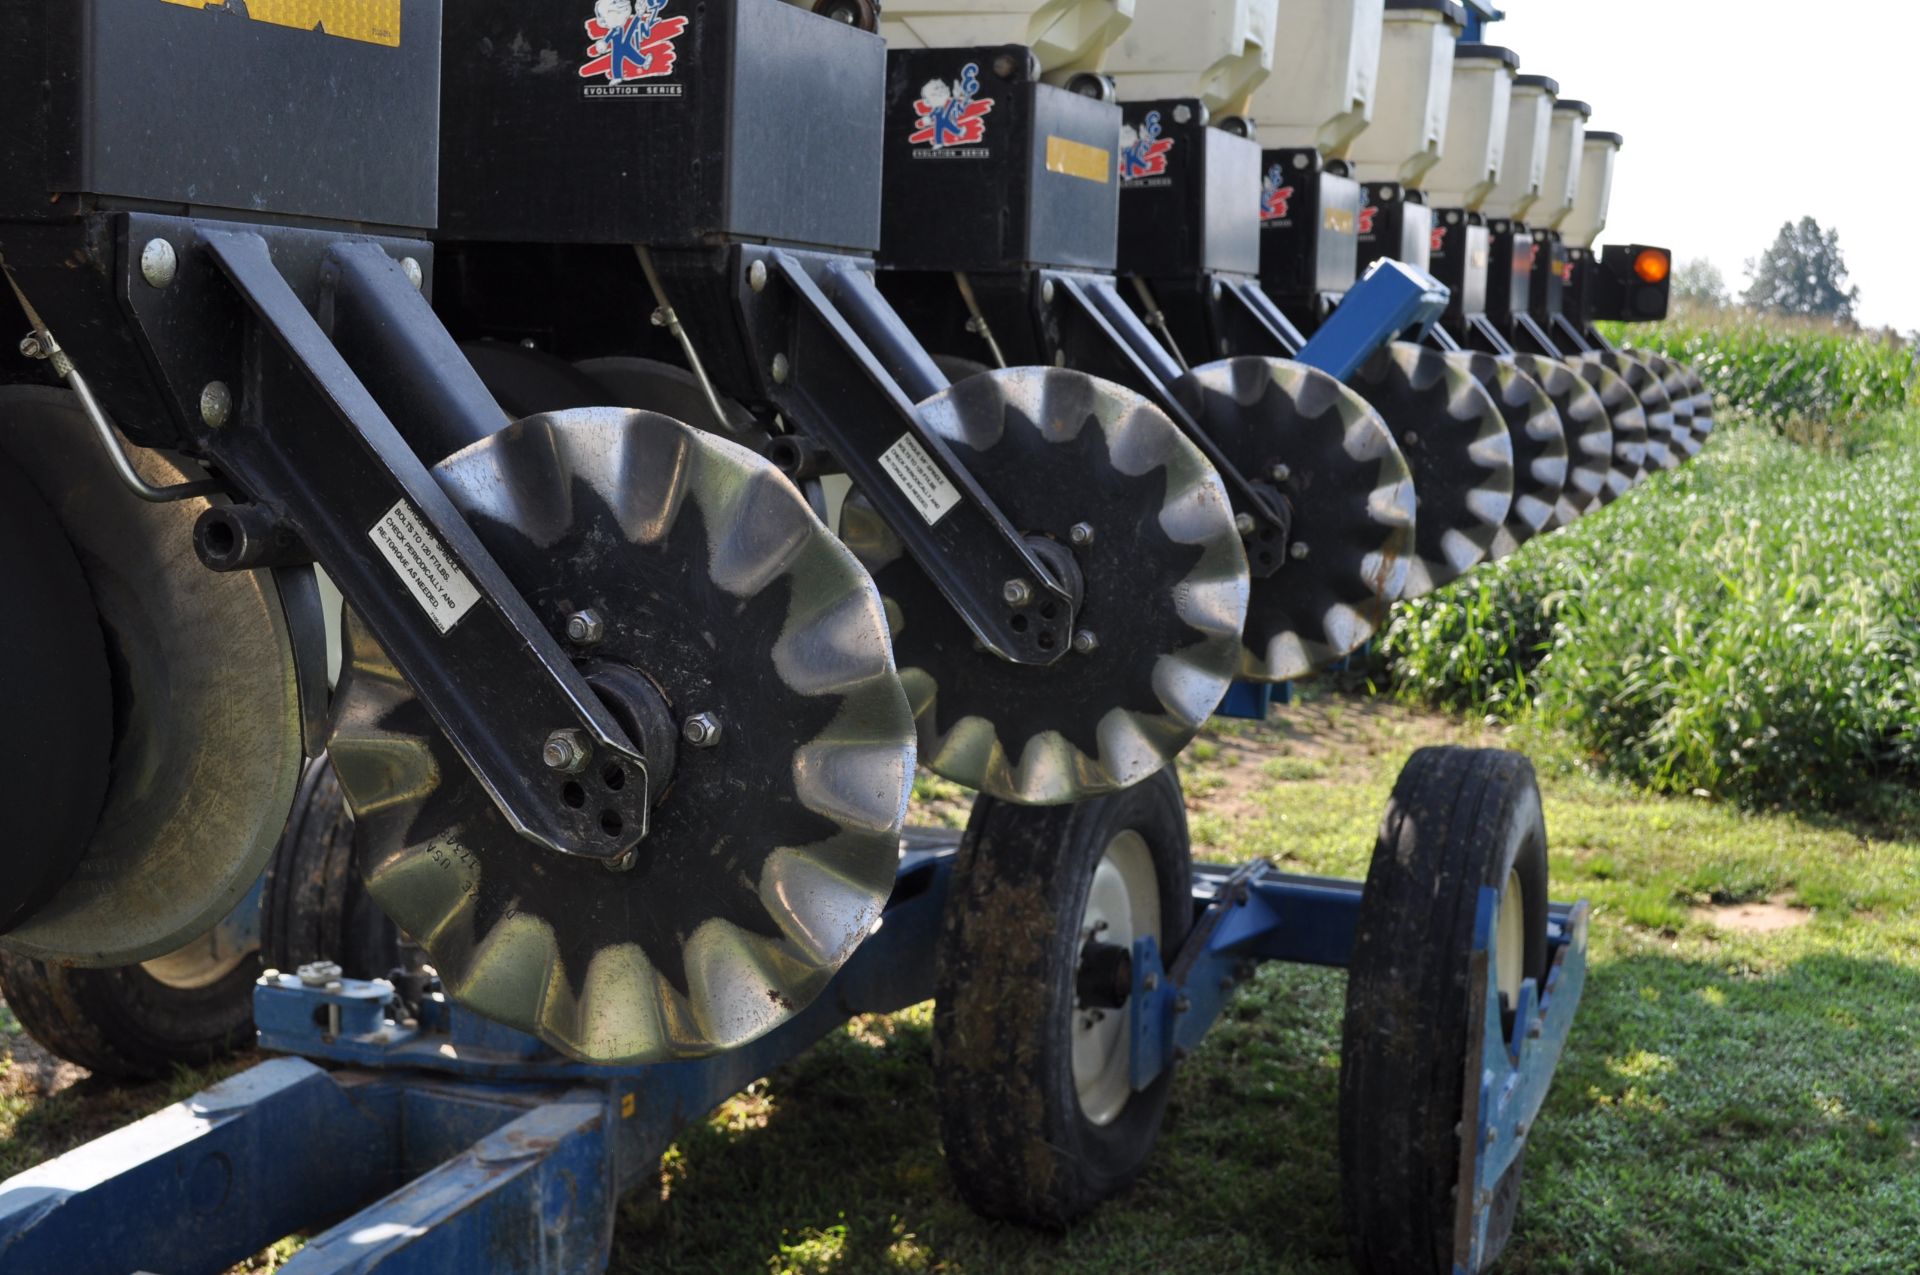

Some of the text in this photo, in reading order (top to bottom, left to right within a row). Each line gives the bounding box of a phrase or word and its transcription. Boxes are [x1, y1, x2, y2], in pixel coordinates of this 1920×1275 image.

[583, 86, 683, 95] EVOLUTION SERIES
[394, 508, 415, 533] BOLTS
[413, 532, 422, 544] TO
[420, 542, 432, 557] 120
[377, 526, 439, 610] RE-TORQUE AS NEEDED.
[385, 517, 456, 609] CHECK PERIODICALLY AND
[435, 543, 460, 574] SPINDLE
[426, 842, 451, 869] USA
